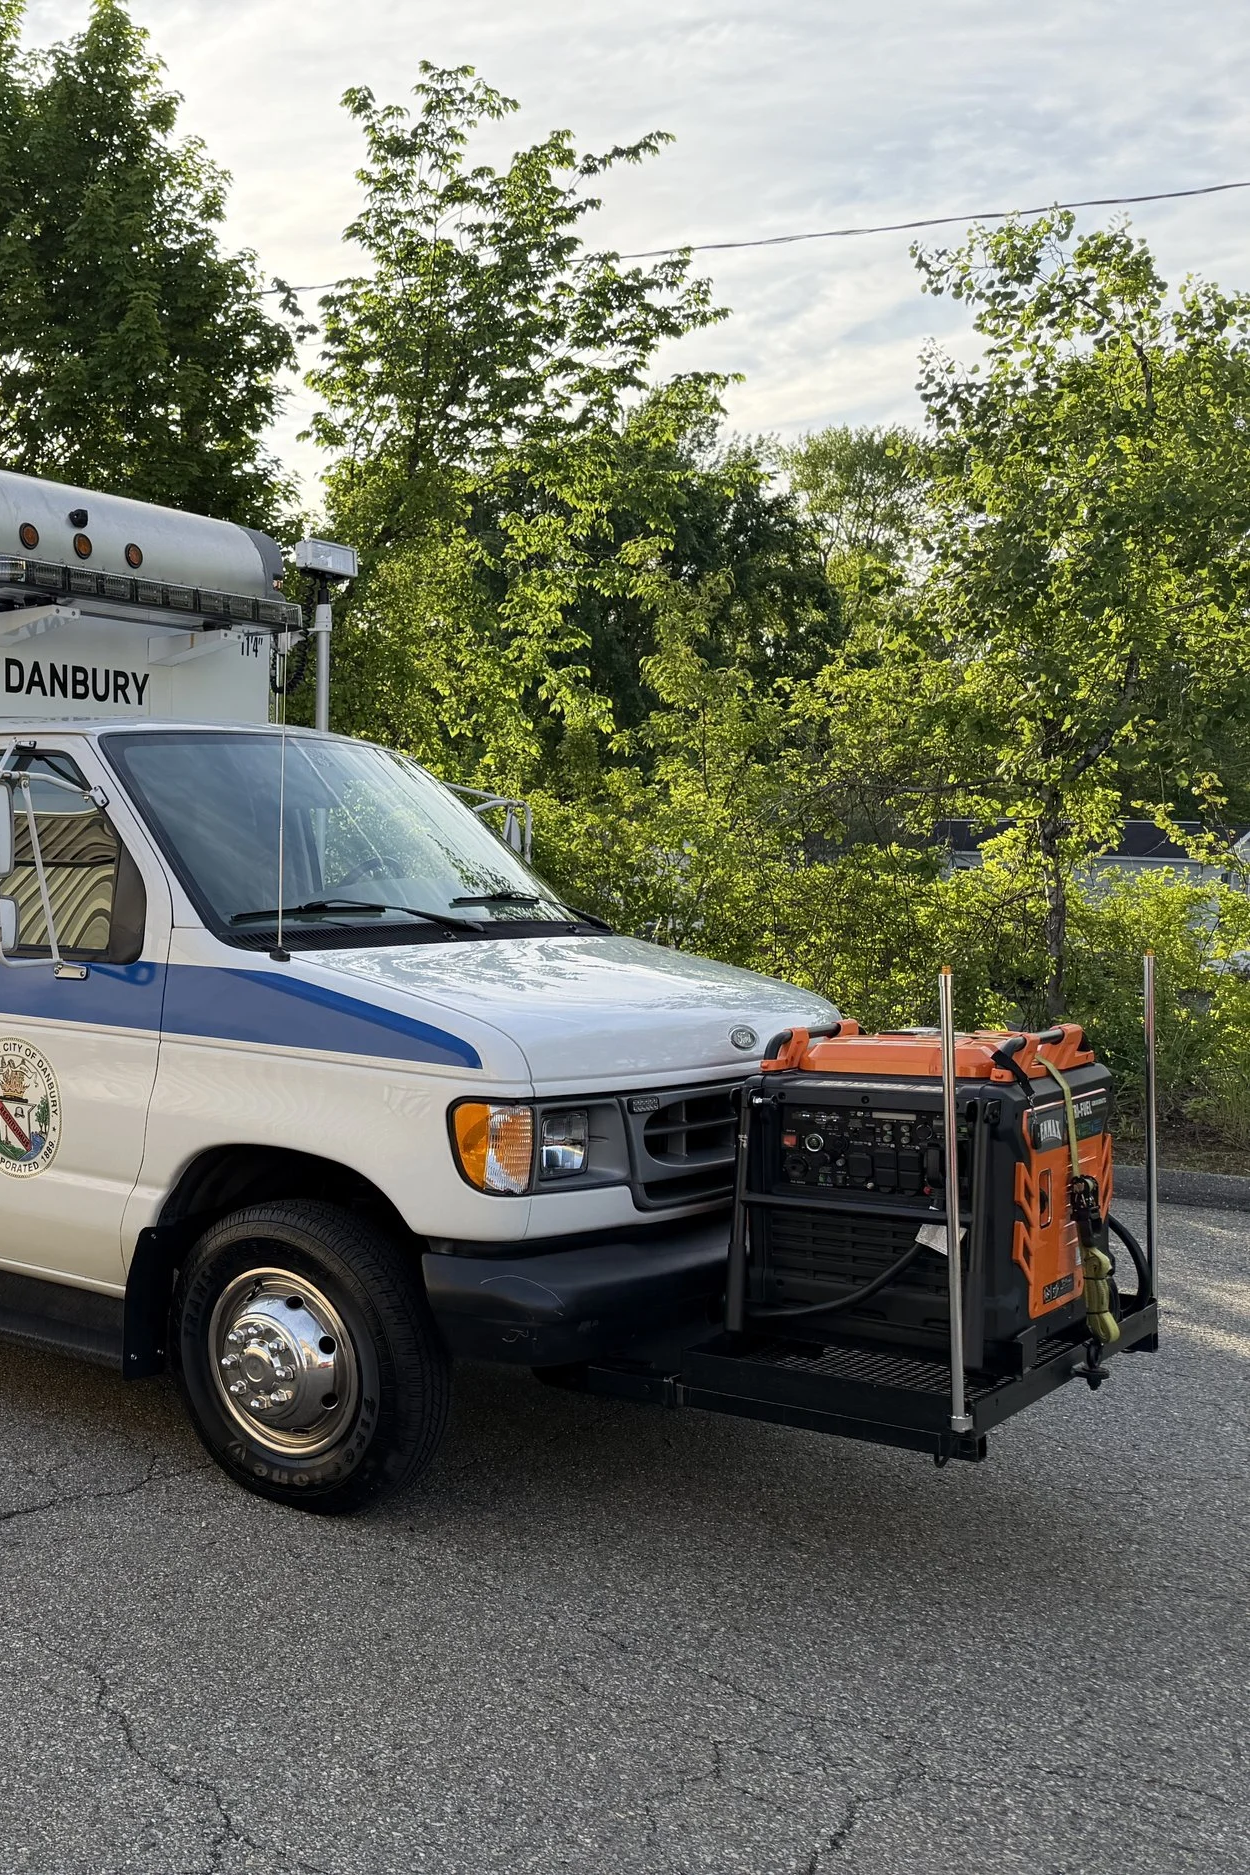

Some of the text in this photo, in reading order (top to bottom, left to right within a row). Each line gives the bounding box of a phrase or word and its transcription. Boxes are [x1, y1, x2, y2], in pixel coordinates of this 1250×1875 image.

[5, 658, 149, 705] DANBURY
[2, 1042, 23, 1053] CITY
[24, 1047, 37, 1060] OF
[1038, 1119, 1062, 1141] ENMAX
